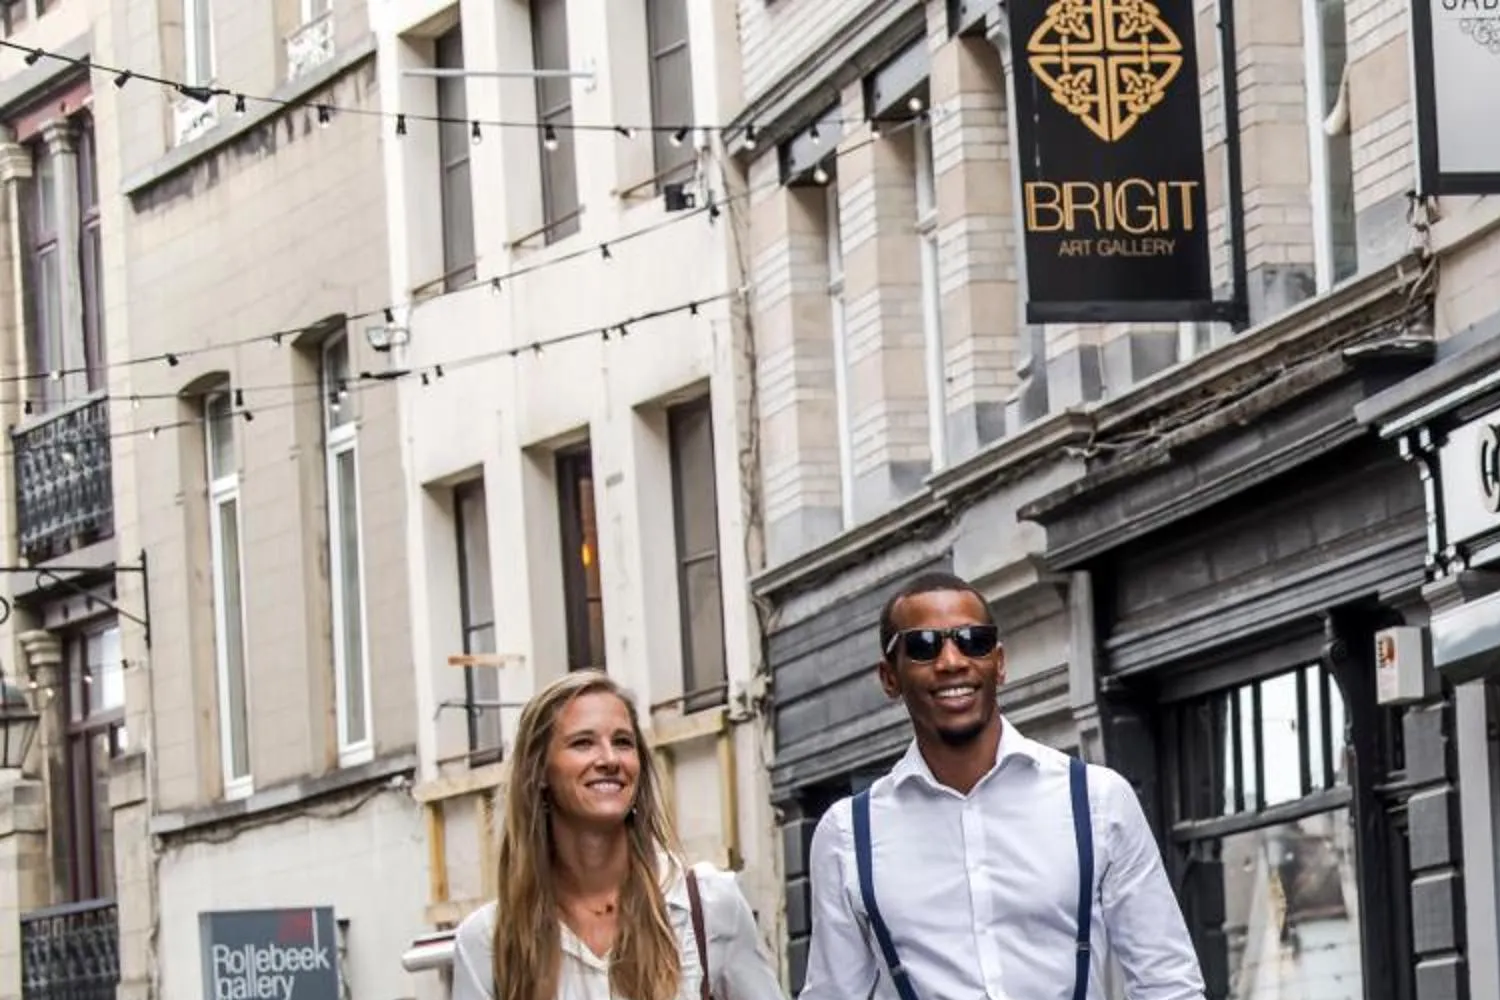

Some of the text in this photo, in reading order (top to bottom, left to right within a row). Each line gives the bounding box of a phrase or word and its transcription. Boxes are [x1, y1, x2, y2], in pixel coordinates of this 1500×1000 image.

[1024, 178, 1199, 233] BRIGIT
[1058, 238, 1176, 257] ART GALLERY
[212, 942, 331, 975] Rollebeek
